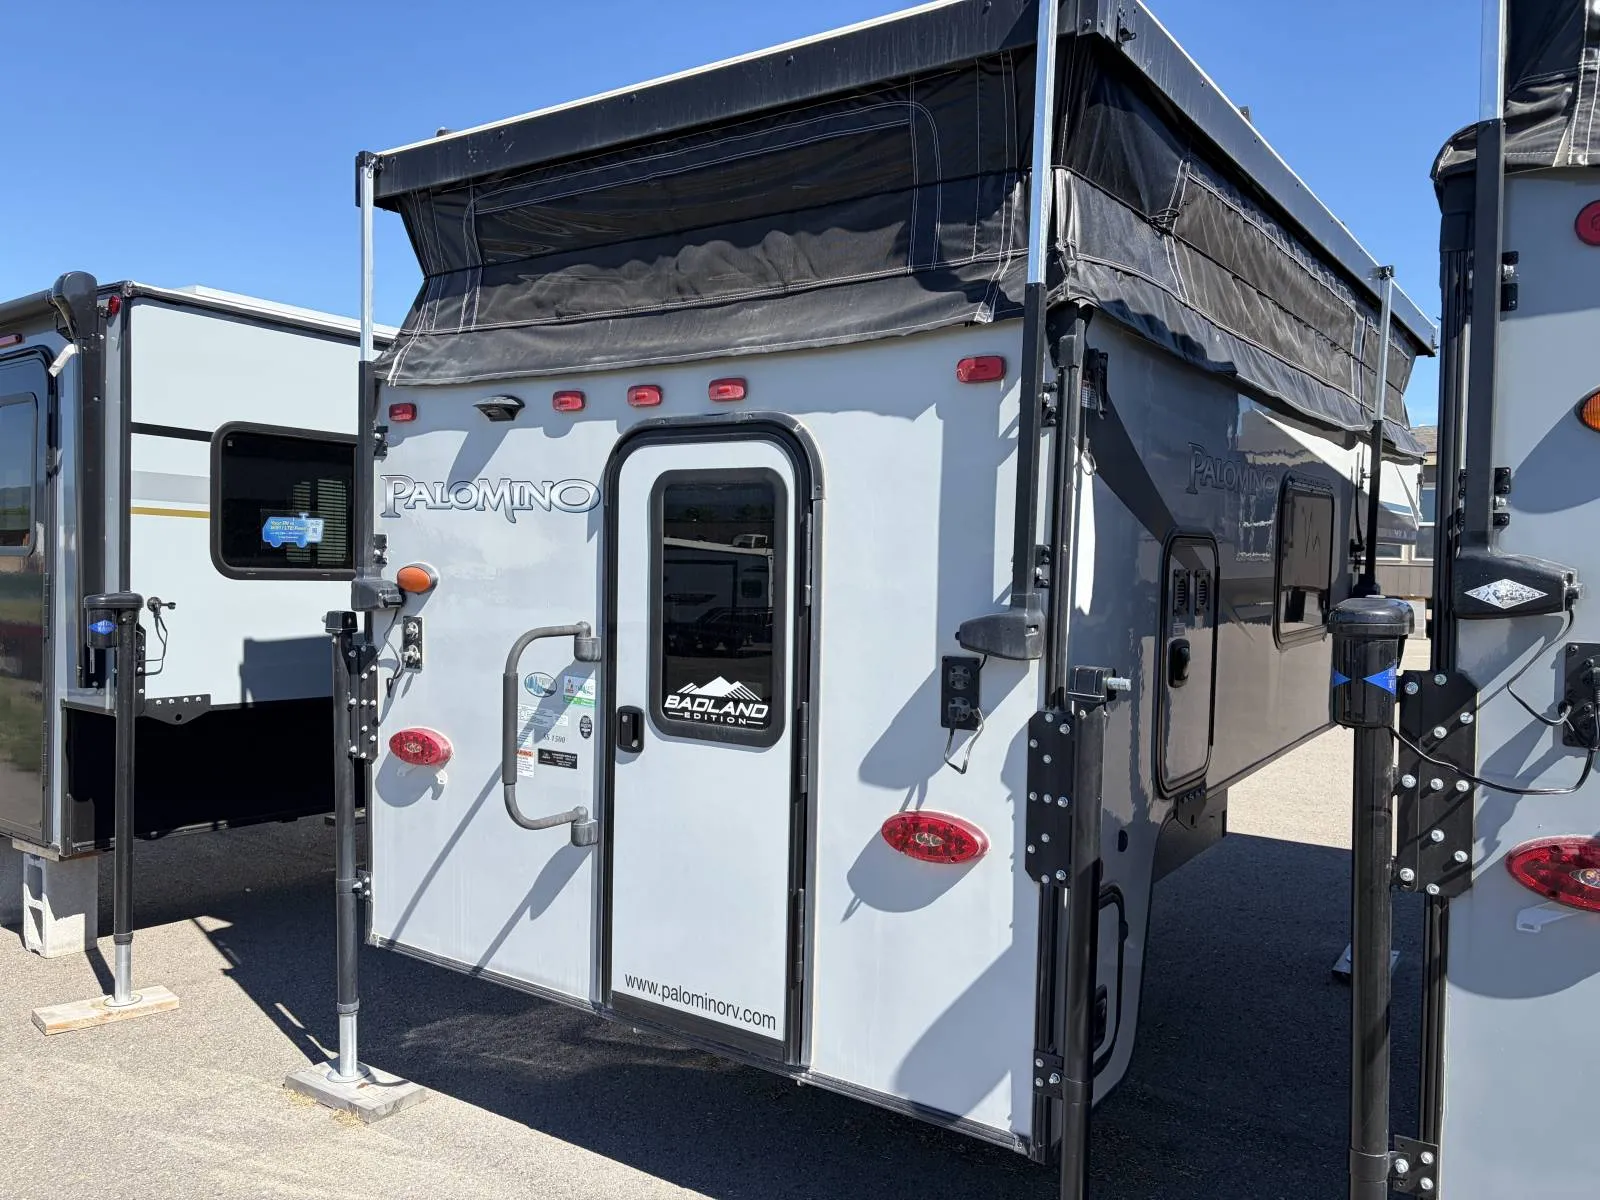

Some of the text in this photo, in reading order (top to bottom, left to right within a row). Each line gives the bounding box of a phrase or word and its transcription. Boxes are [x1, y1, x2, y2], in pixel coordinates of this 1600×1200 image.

[1185, 441, 1279, 497] PALOMINO
[380, 474, 600, 523] PALOMINO
[664, 694, 769, 718] BADLAND
[684, 711, 747, 725] EDITION
[624, 973, 776, 1031] www.palominorv.com
